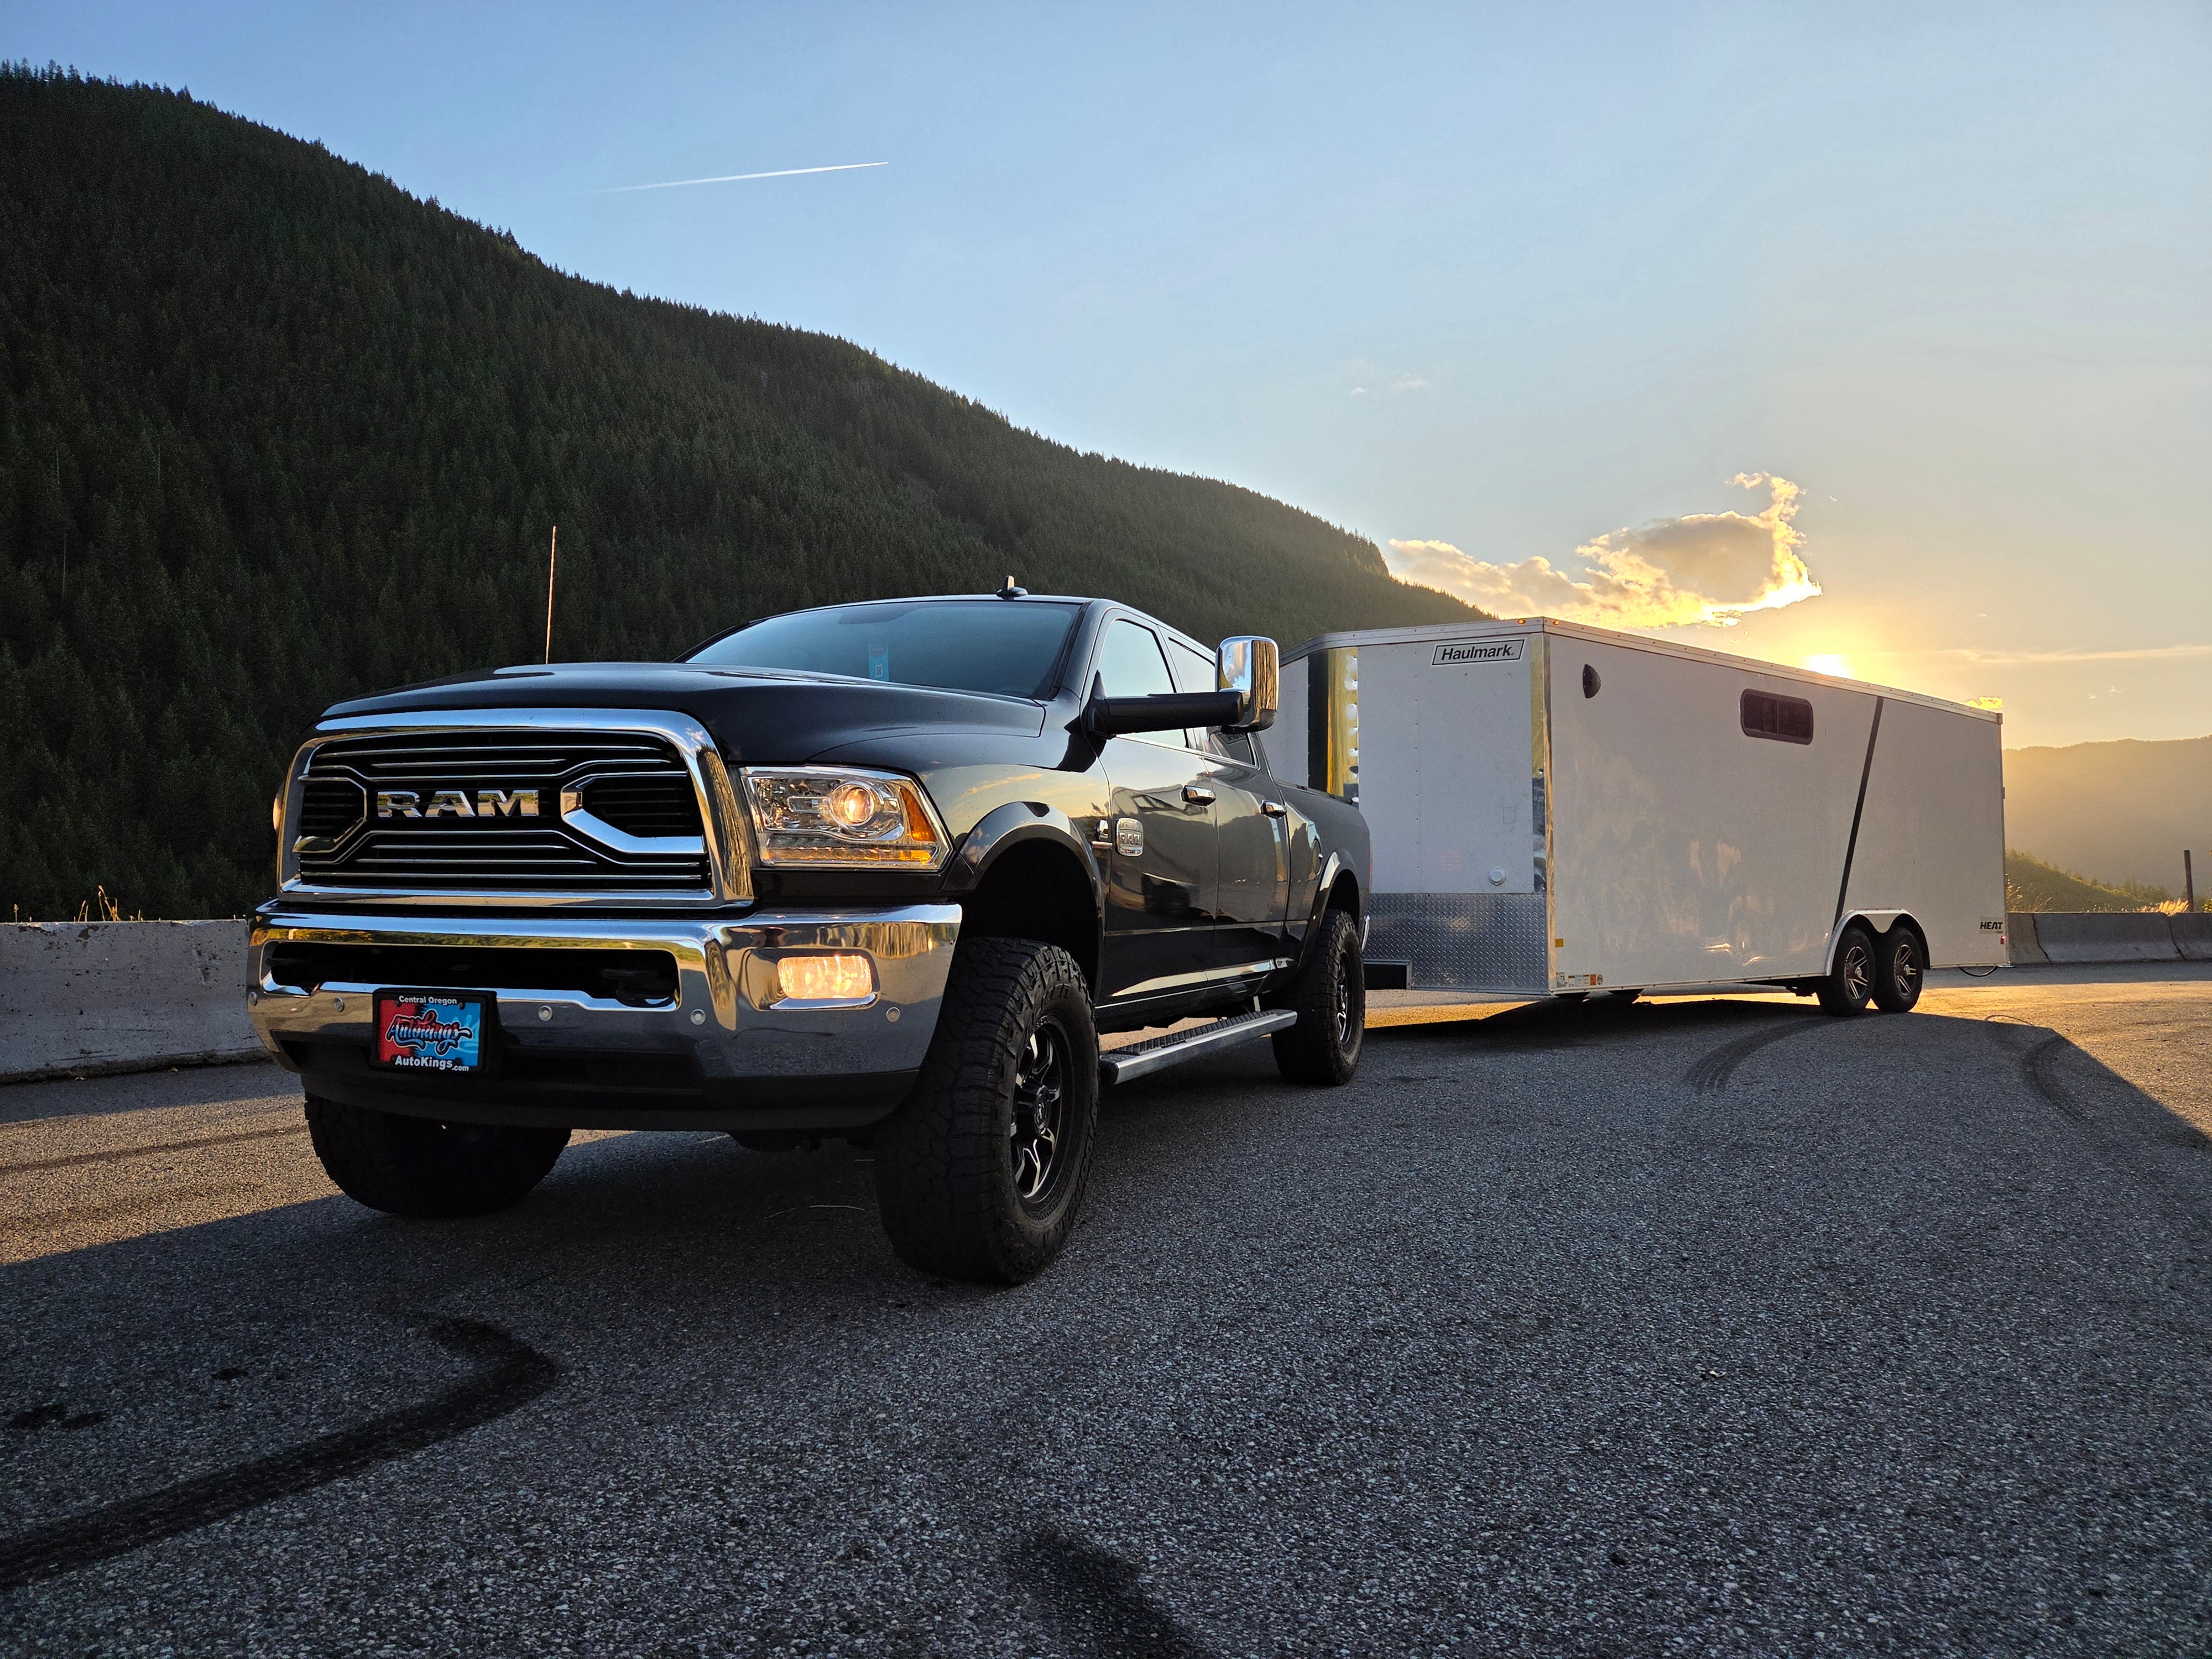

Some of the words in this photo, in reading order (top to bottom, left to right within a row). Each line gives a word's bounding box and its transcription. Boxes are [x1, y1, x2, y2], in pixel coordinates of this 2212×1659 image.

[1441, 644, 1512, 660] Haulmark
[377, 789, 539, 818] RAM
[1980, 921, 2003, 930] HEAT
[399, 995, 426, 1004] Central
[428, 997, 457, 1005] Oregon
[395, 1055, 469, 1072] AutoKings.com
